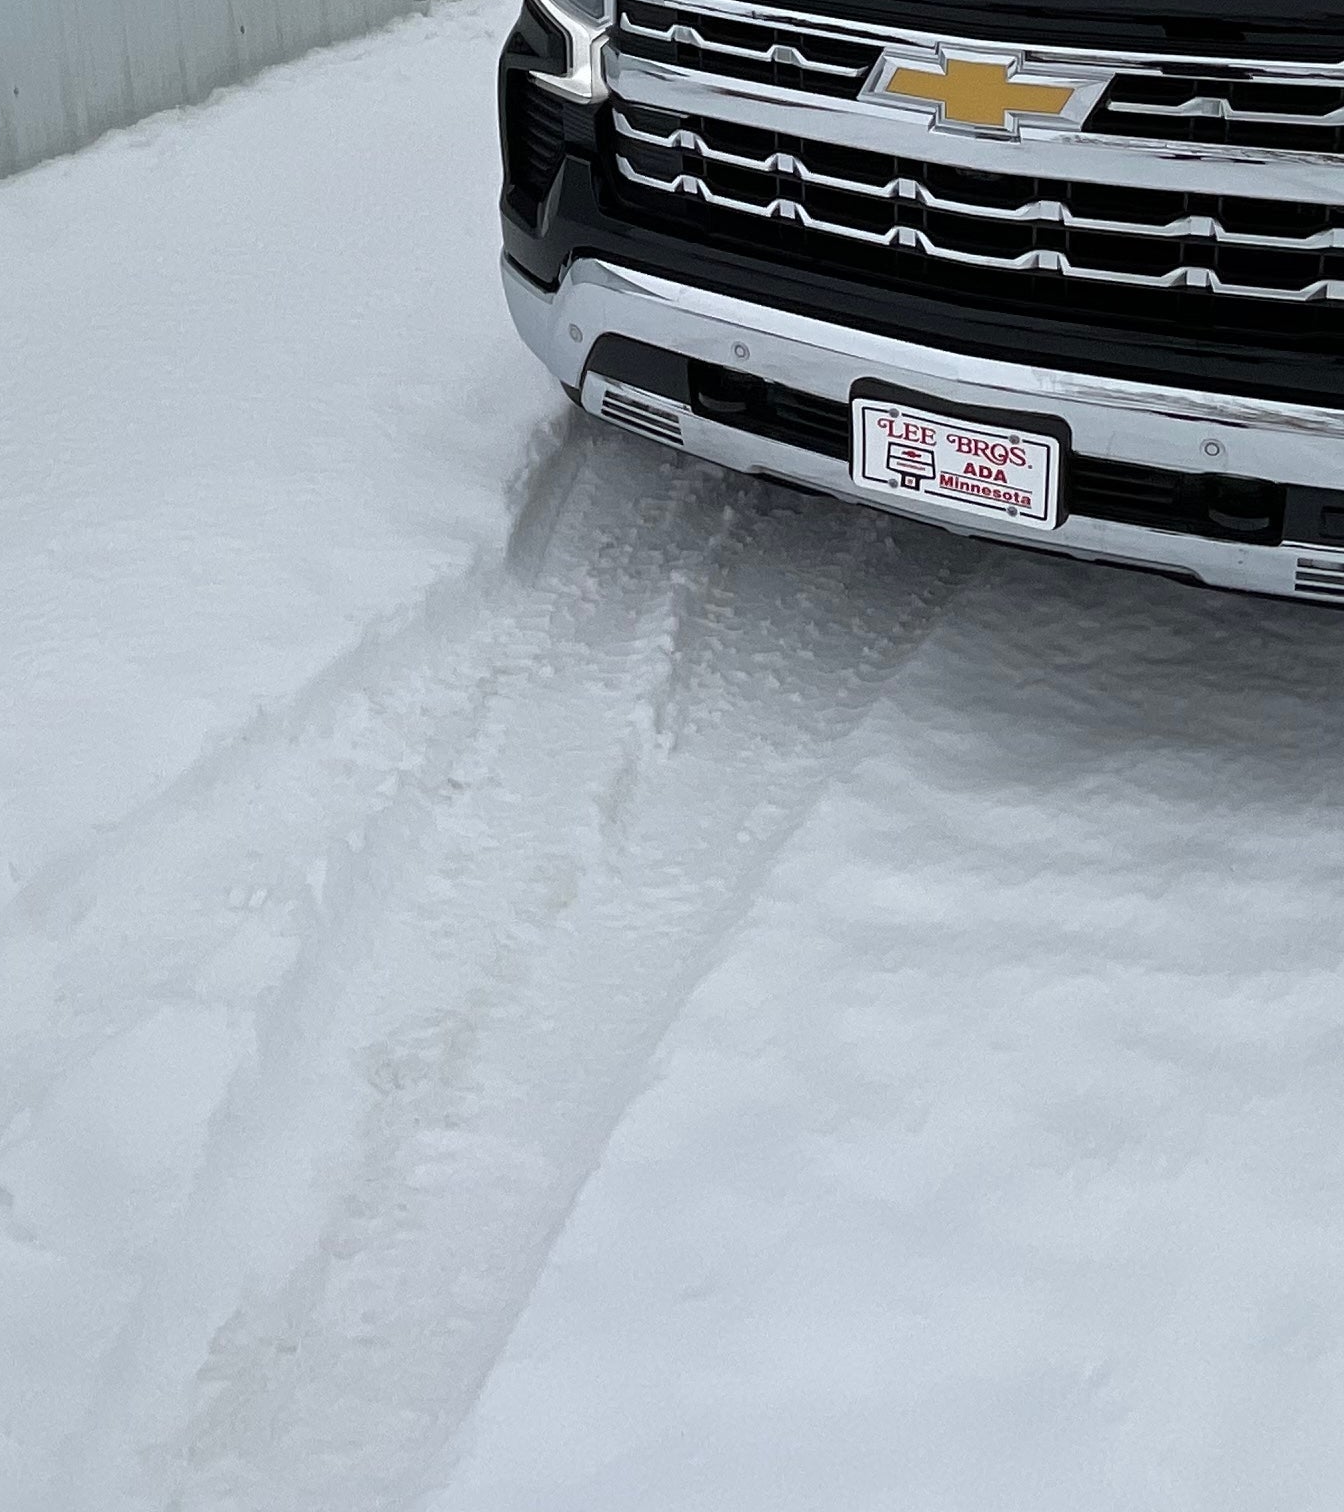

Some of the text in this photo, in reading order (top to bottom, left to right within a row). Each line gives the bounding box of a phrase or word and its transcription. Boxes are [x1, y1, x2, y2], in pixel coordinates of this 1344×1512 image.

[877, 418, 1033, 469] LEE BROS.
[963, 462, 1008, 484] ADA
[939, 474, 1032, 506] Minnesota
